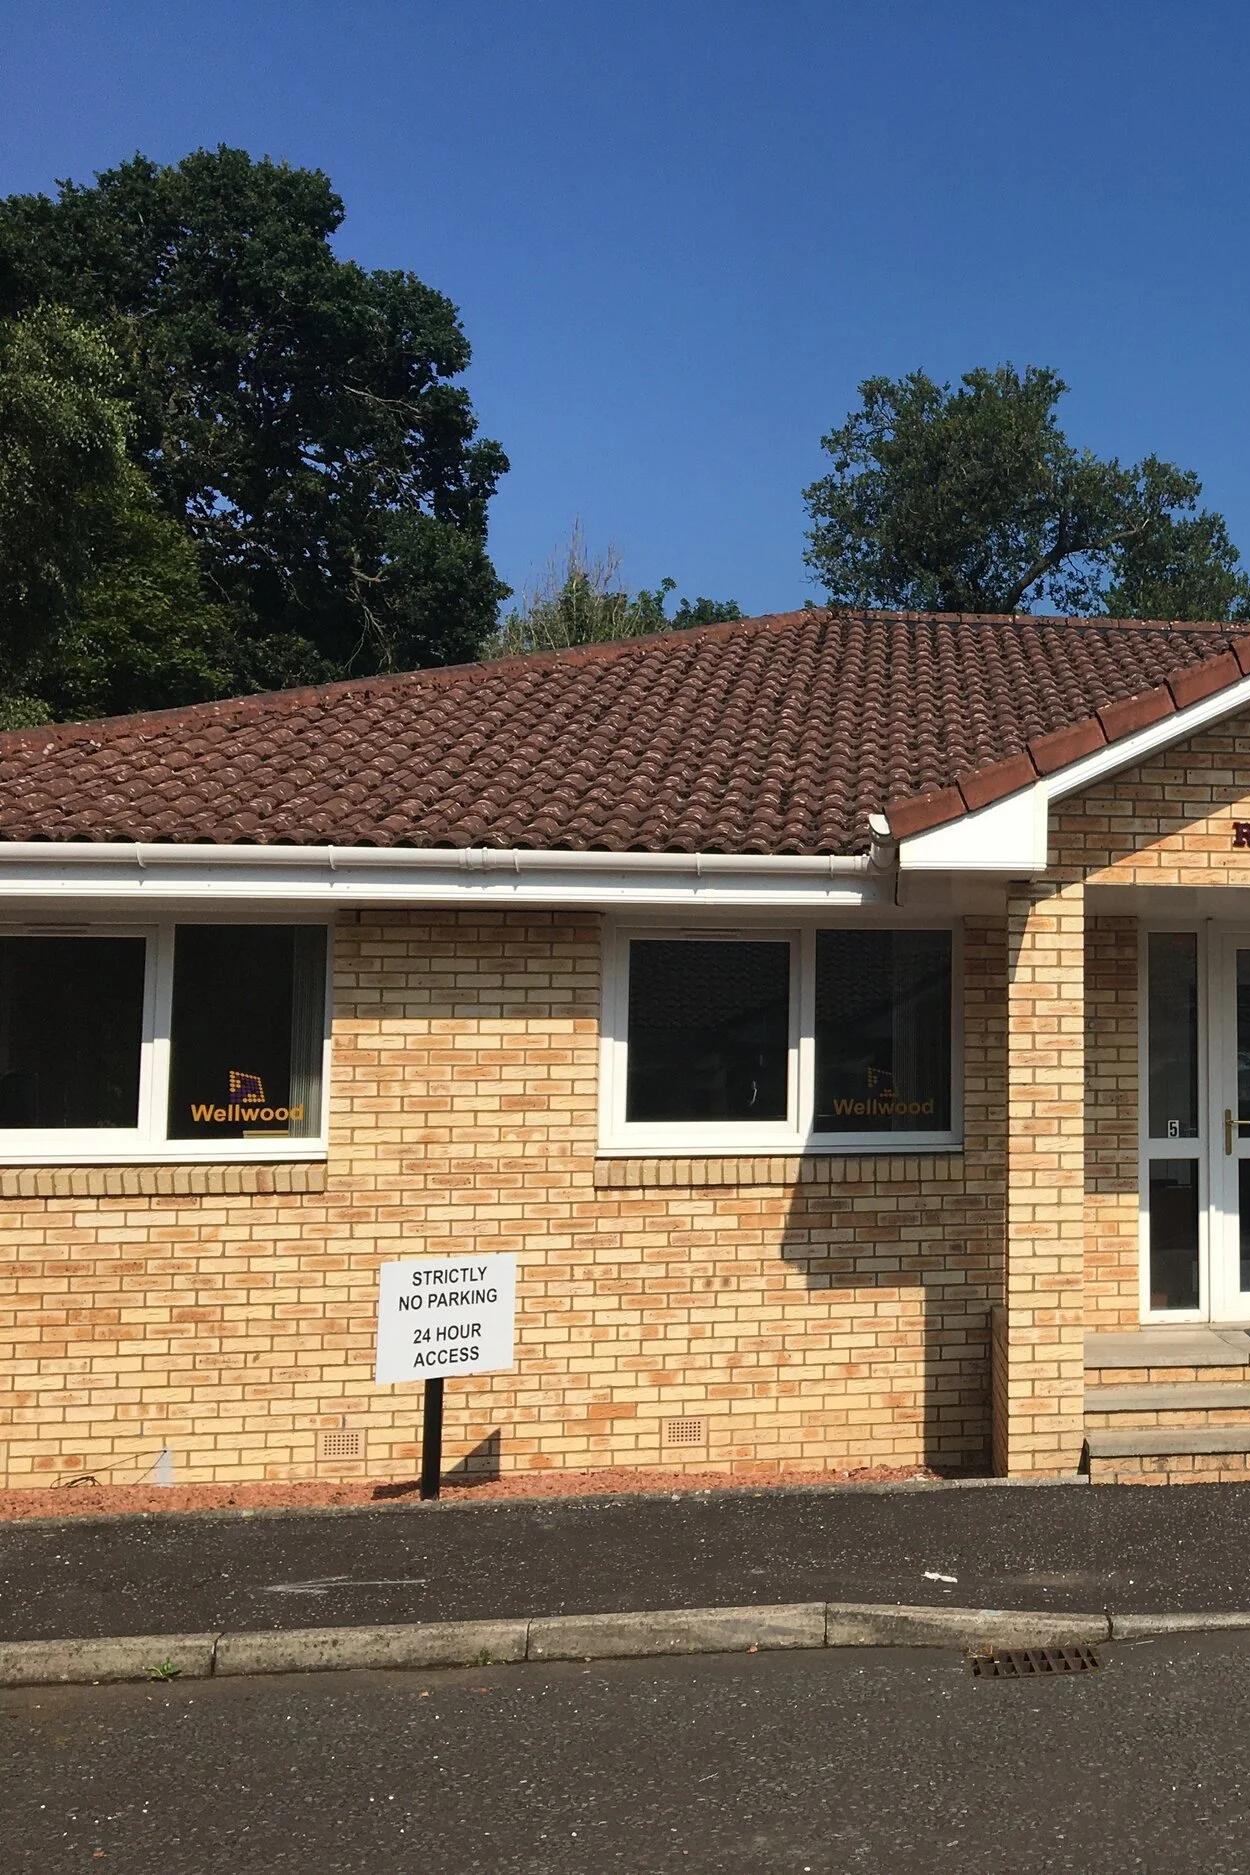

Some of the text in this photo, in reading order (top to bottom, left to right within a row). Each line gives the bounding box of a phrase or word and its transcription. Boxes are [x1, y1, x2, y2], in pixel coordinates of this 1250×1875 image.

[190, 1103, 304, 1122] Wellwood
[833, 1098, 934, 1116] Wellwood
[1169, 1121, 1178, 1138] 5
[412, 1266, 488, 1287] STRICTLY
[399, 1288, 498, 1311] NO PARKING
[413, 1323, 482, 1344] 24 HOUR
[413, 1346, 480, 1368] ACCESS
